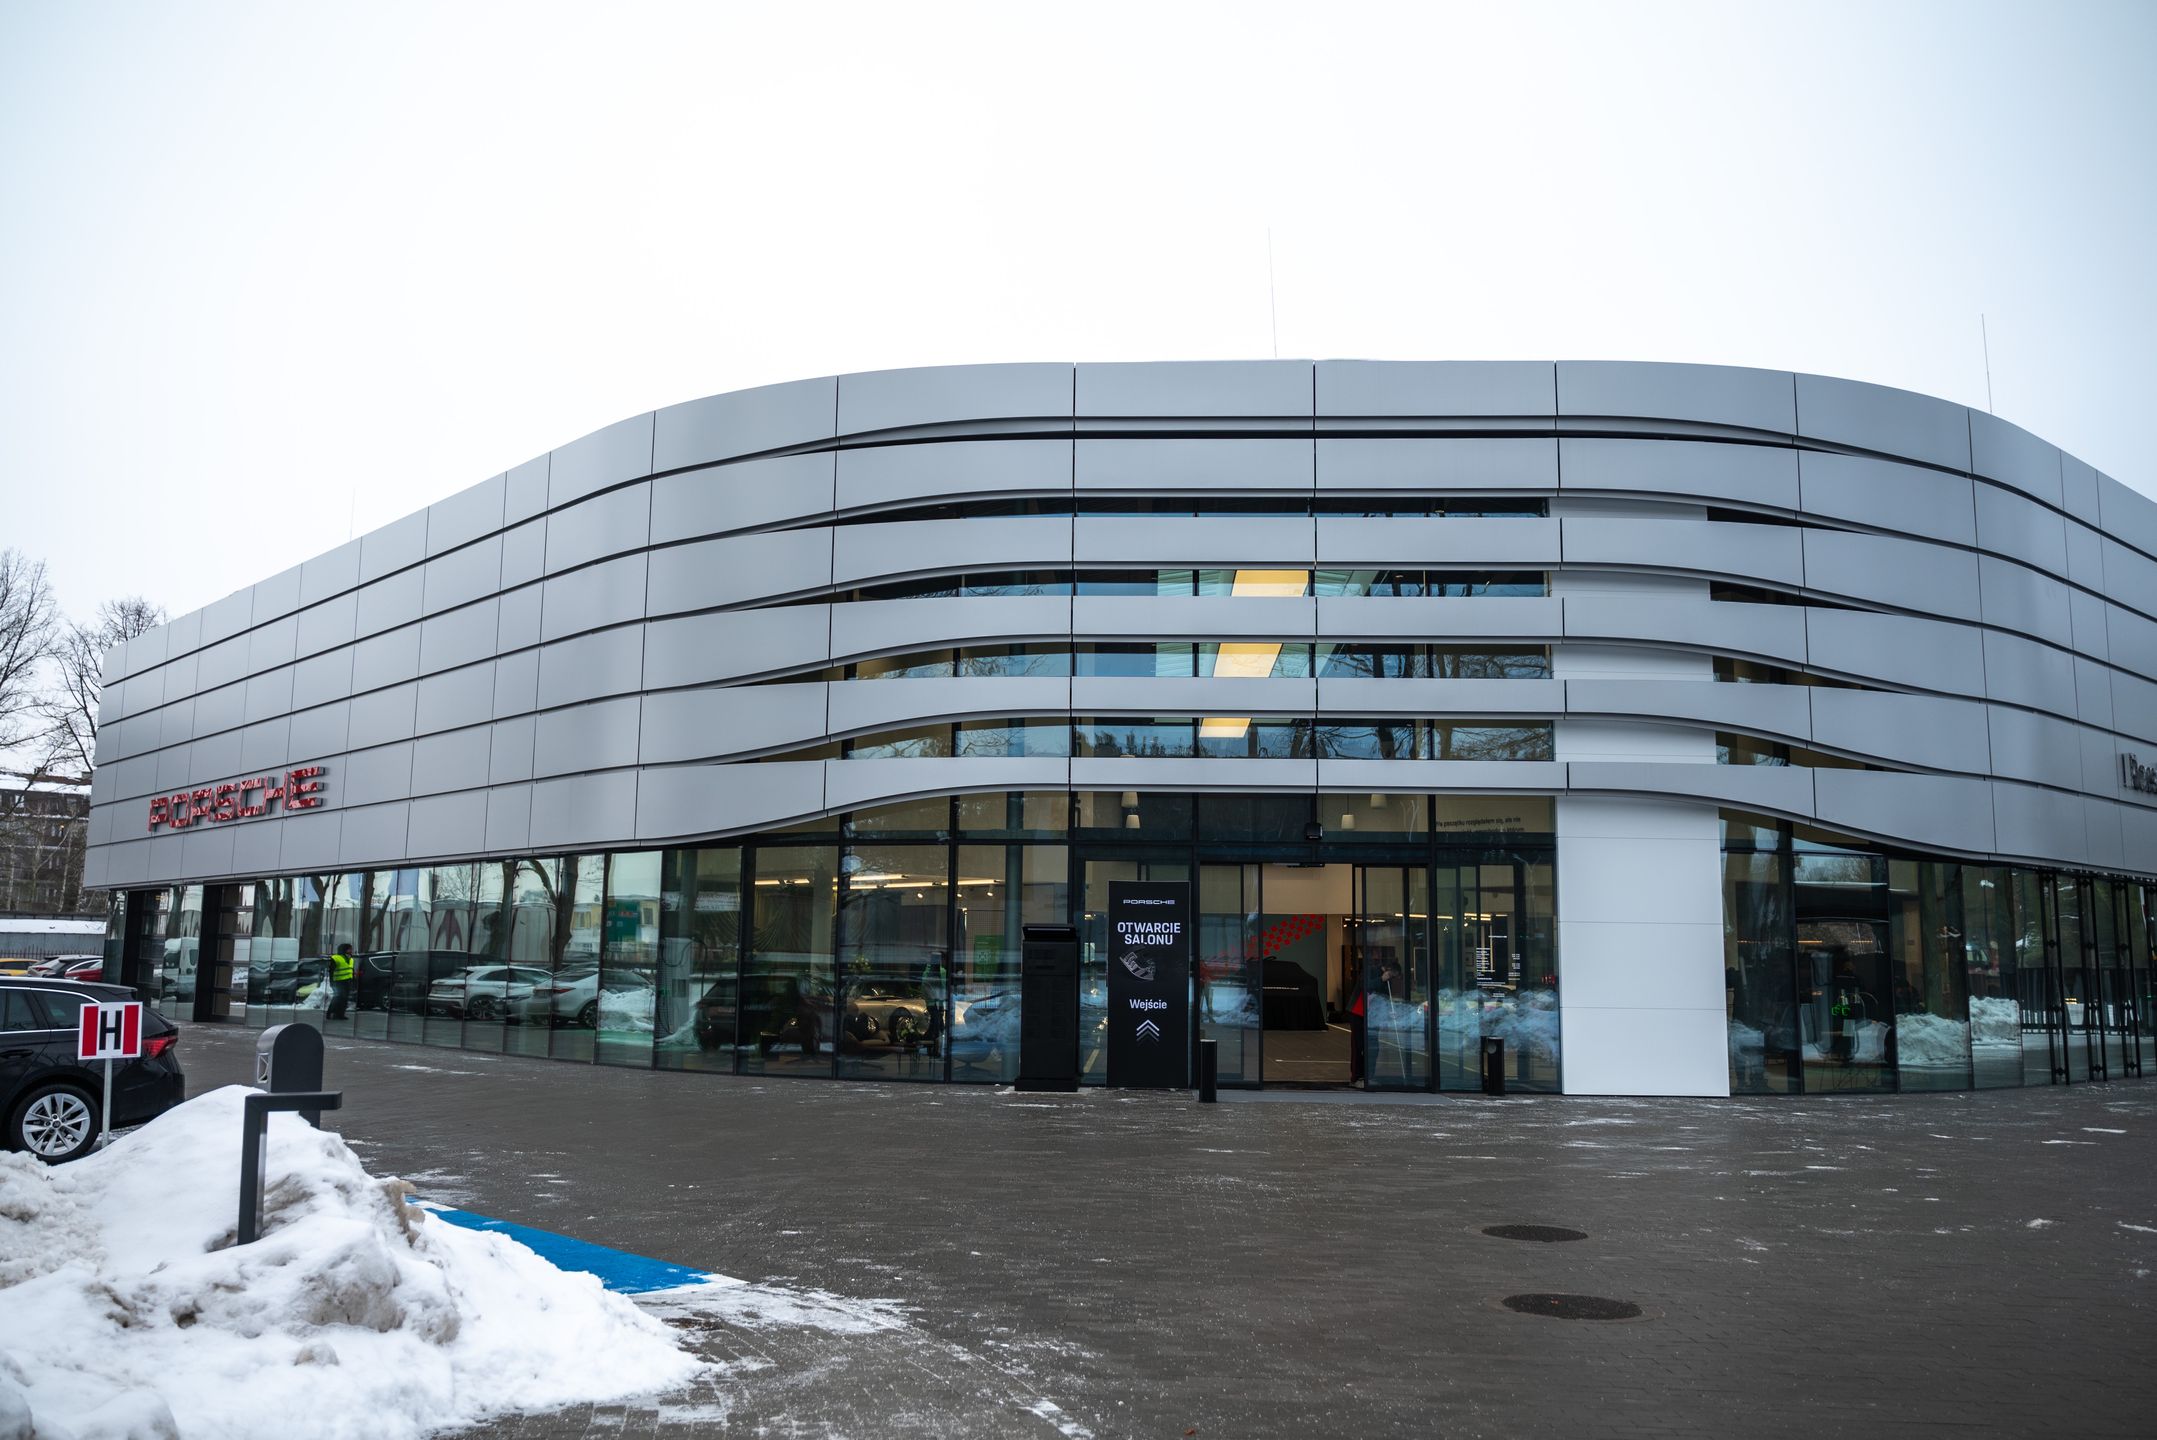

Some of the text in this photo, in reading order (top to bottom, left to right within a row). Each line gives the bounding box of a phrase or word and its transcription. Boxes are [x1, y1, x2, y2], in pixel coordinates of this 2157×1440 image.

[148, 766, 326, 832] PORSCHE
[1117, 921, 1181, 934] OTWARCIE
[1124, 933, 1173, 945] SALONU
[1129, 998, 1168, 1011] Wejście
[99, 1010, 122, 1050] H
